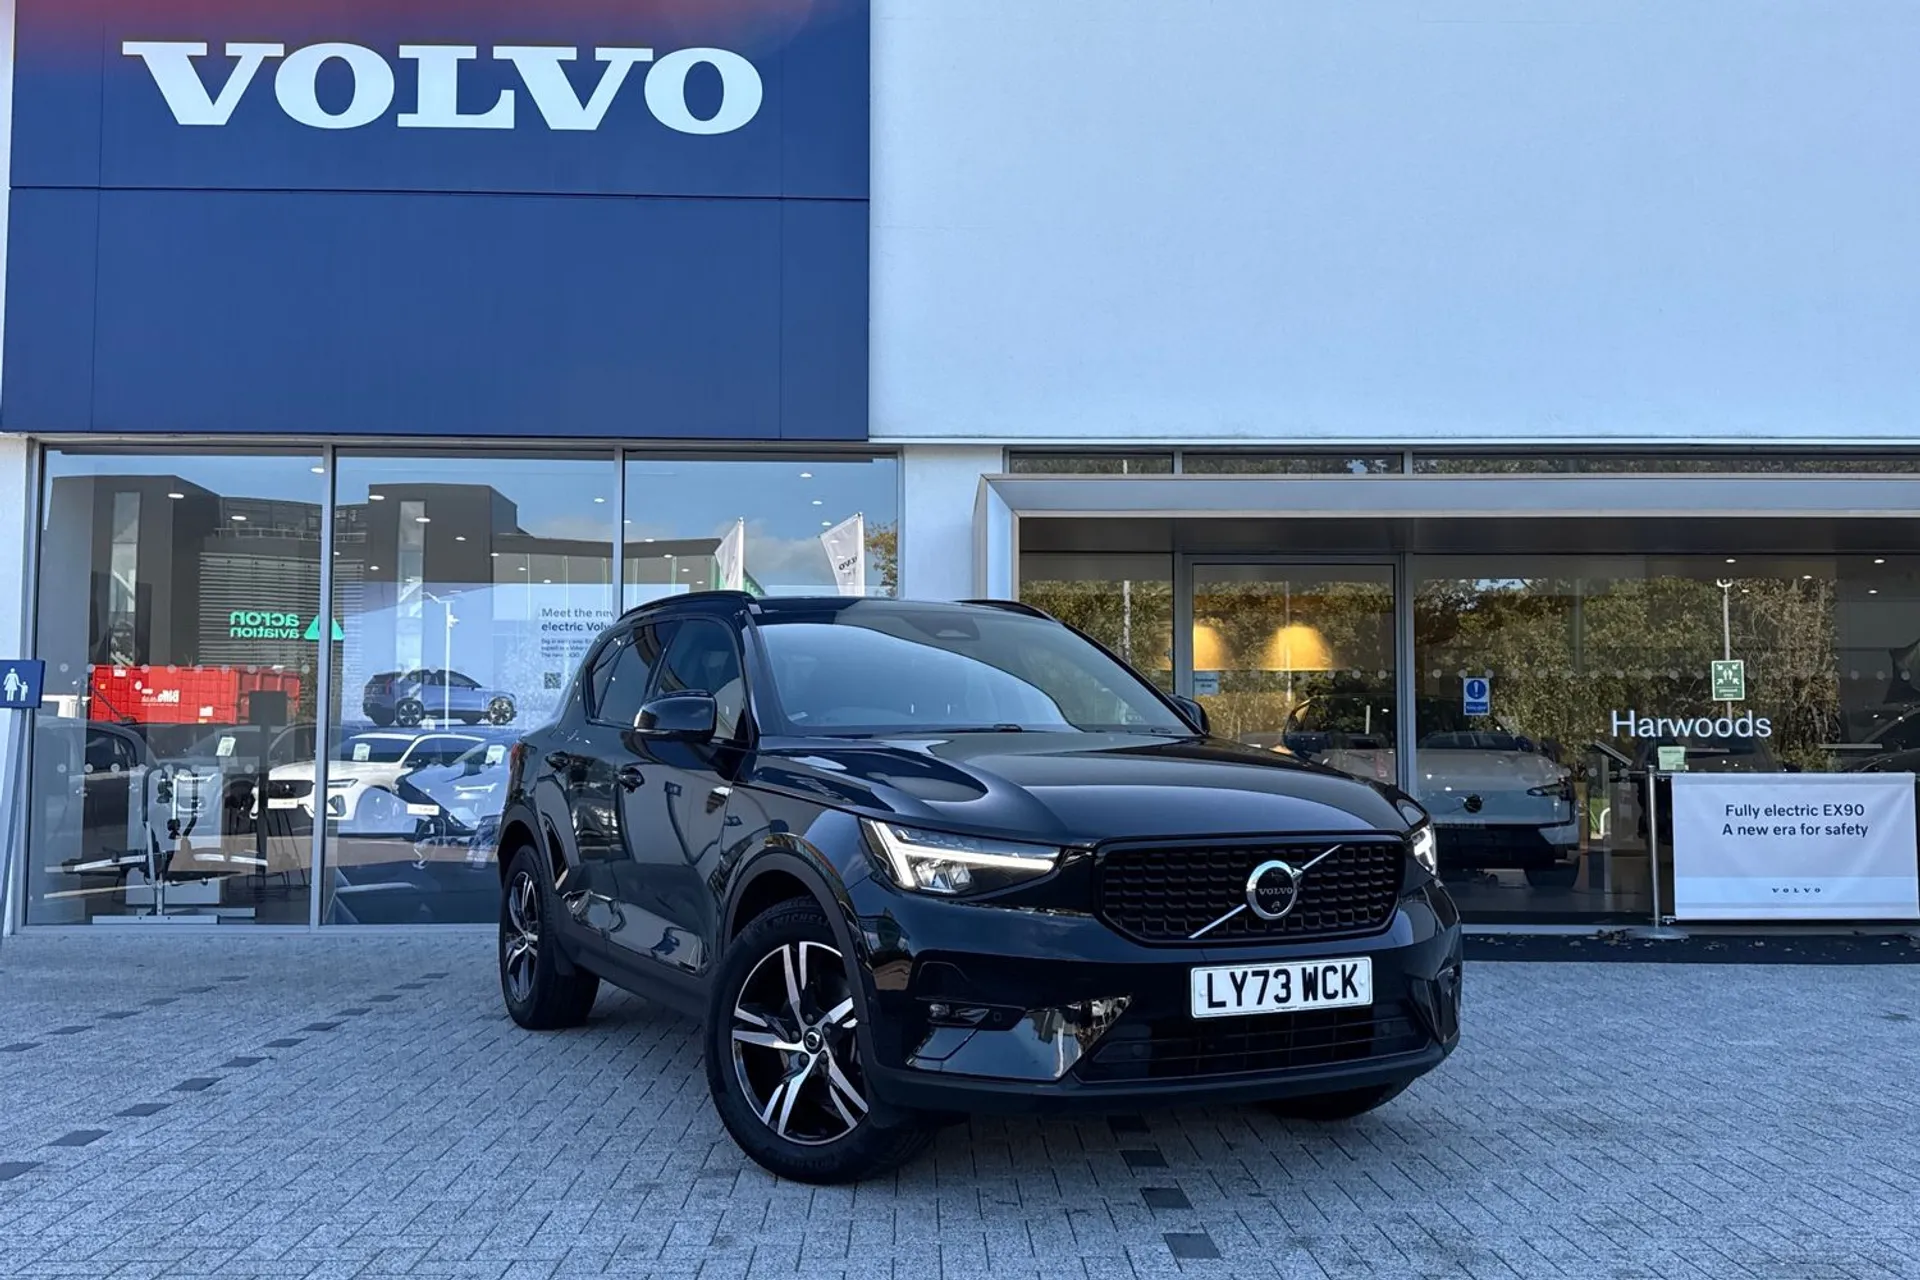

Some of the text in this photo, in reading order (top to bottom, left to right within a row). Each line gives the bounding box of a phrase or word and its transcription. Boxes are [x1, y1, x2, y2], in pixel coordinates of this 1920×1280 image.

[122, 41, 763, 134] VOLVO
[541, 608, 571, 617] Meet
[574, 608, 592, 617] the
[541, 622, 583, 631] electric
[1611, 709, 1772, 738] Harwoods
[1725, 804, 1865, 819] Fully electric EX90
[1722, 823, 1868, 838] A new era for safety
[1259, 887, 1293, 895] VOLVO
[1207, 963, 1359, 1008] LY73 WCK
